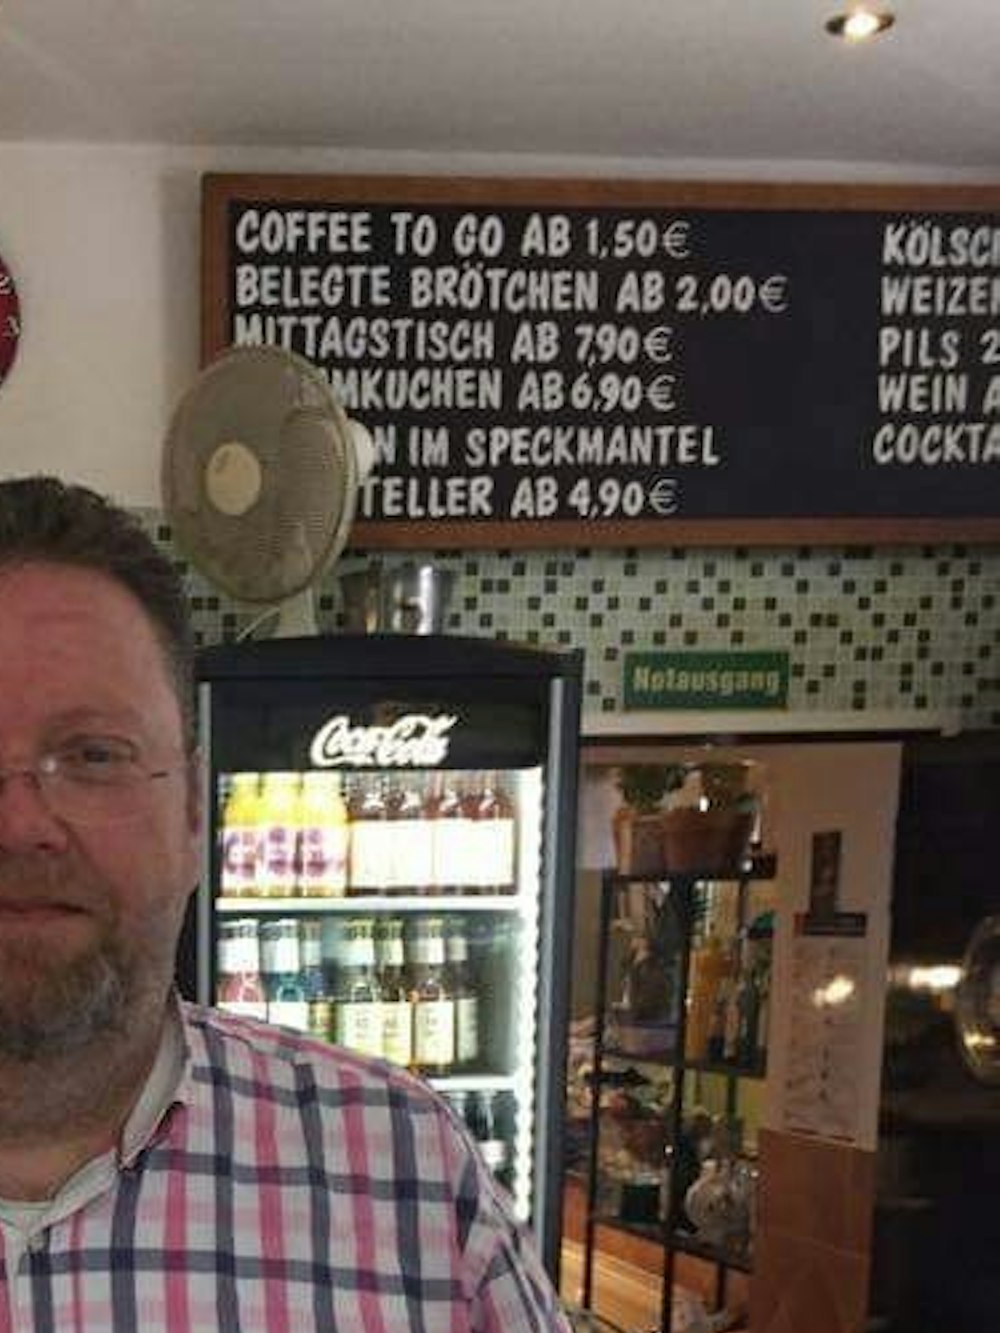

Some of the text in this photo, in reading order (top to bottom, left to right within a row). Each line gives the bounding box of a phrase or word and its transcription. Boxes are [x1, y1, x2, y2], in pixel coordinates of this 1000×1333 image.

[236, 211, 692, 260] COFFEE TO GO AB 1,50€
[235, 263, 790, 316] BELEGTE BRÖTCHEN AB 2,00€
[234, 316, 674, 367] MITTAGSTISCH AB 7,90€
[879, 326, 961, 369] PILS
[326, 369, 677, 413] MKUCHEN AB 6,90€
[877, 373, 968, 414] WEIN
[408, 426, 450, 466] IM
[464, 424, 719, 467] SPECKMANTEL
[360, 476, 680, 521] TELLER AB 4,90€
[633, 665, 780, 697] Notausgang
